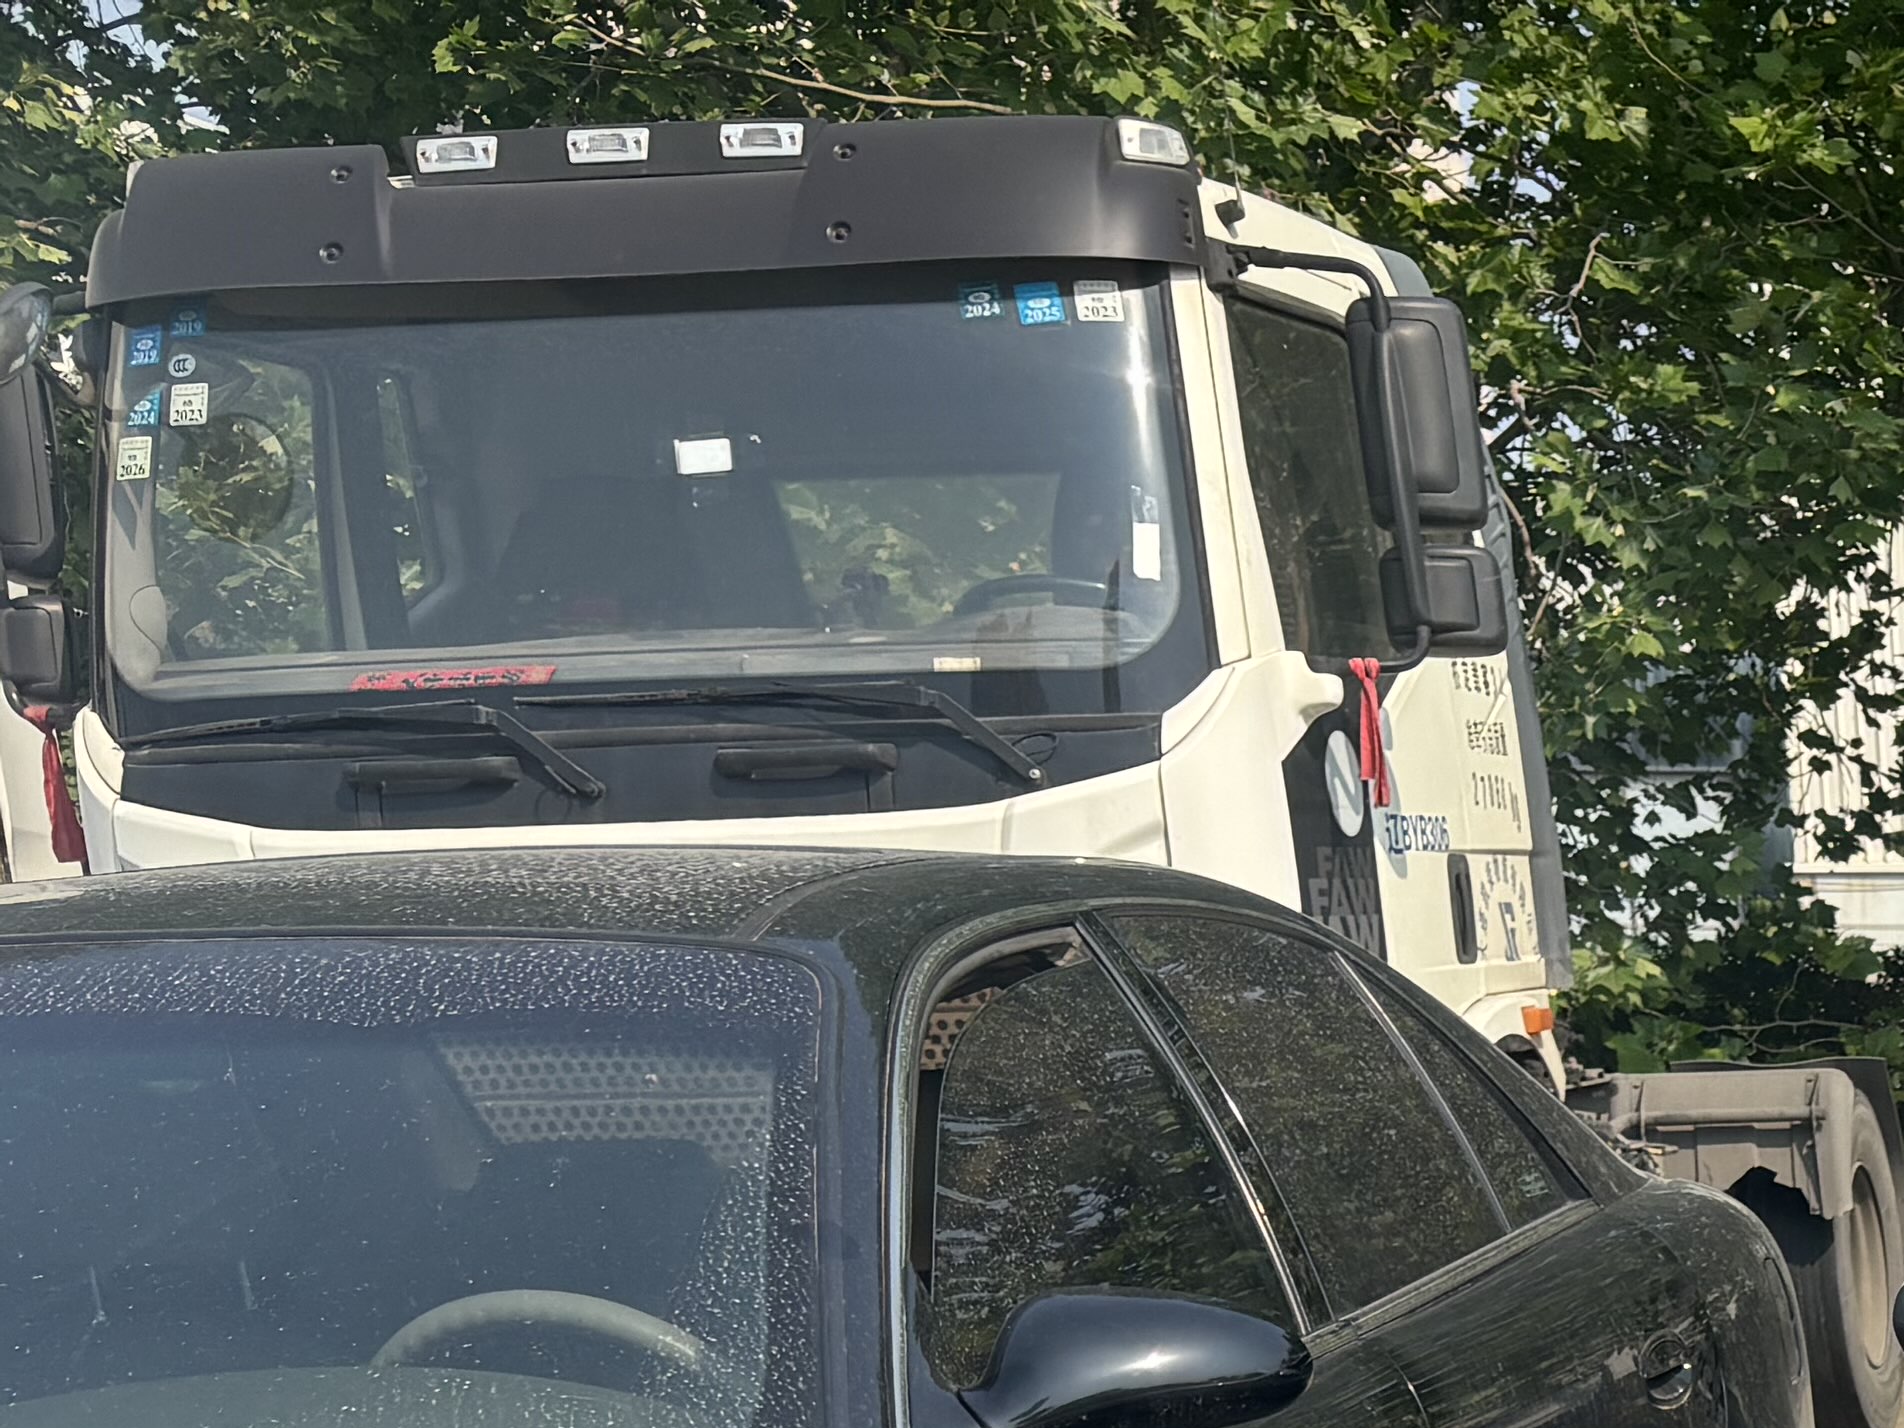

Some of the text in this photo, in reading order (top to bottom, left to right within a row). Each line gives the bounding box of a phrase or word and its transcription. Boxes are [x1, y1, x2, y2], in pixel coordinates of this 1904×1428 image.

[964, 302, 1001, 318] 2024
[1024, 307, 1061, 323] 2025
[1083, 306, 1119, 318] 2023
[172, 321, 203, 335] 2019
[128, 412, 155, 426] 2024
[173, 409, 203, 422] 2023
[120, 463, 146, 478] 2026
[1316, 845, 1373, 878] FAW
[1308, 878, 1376, 915] FAW
[1312, 914, 1380, 957] AW
